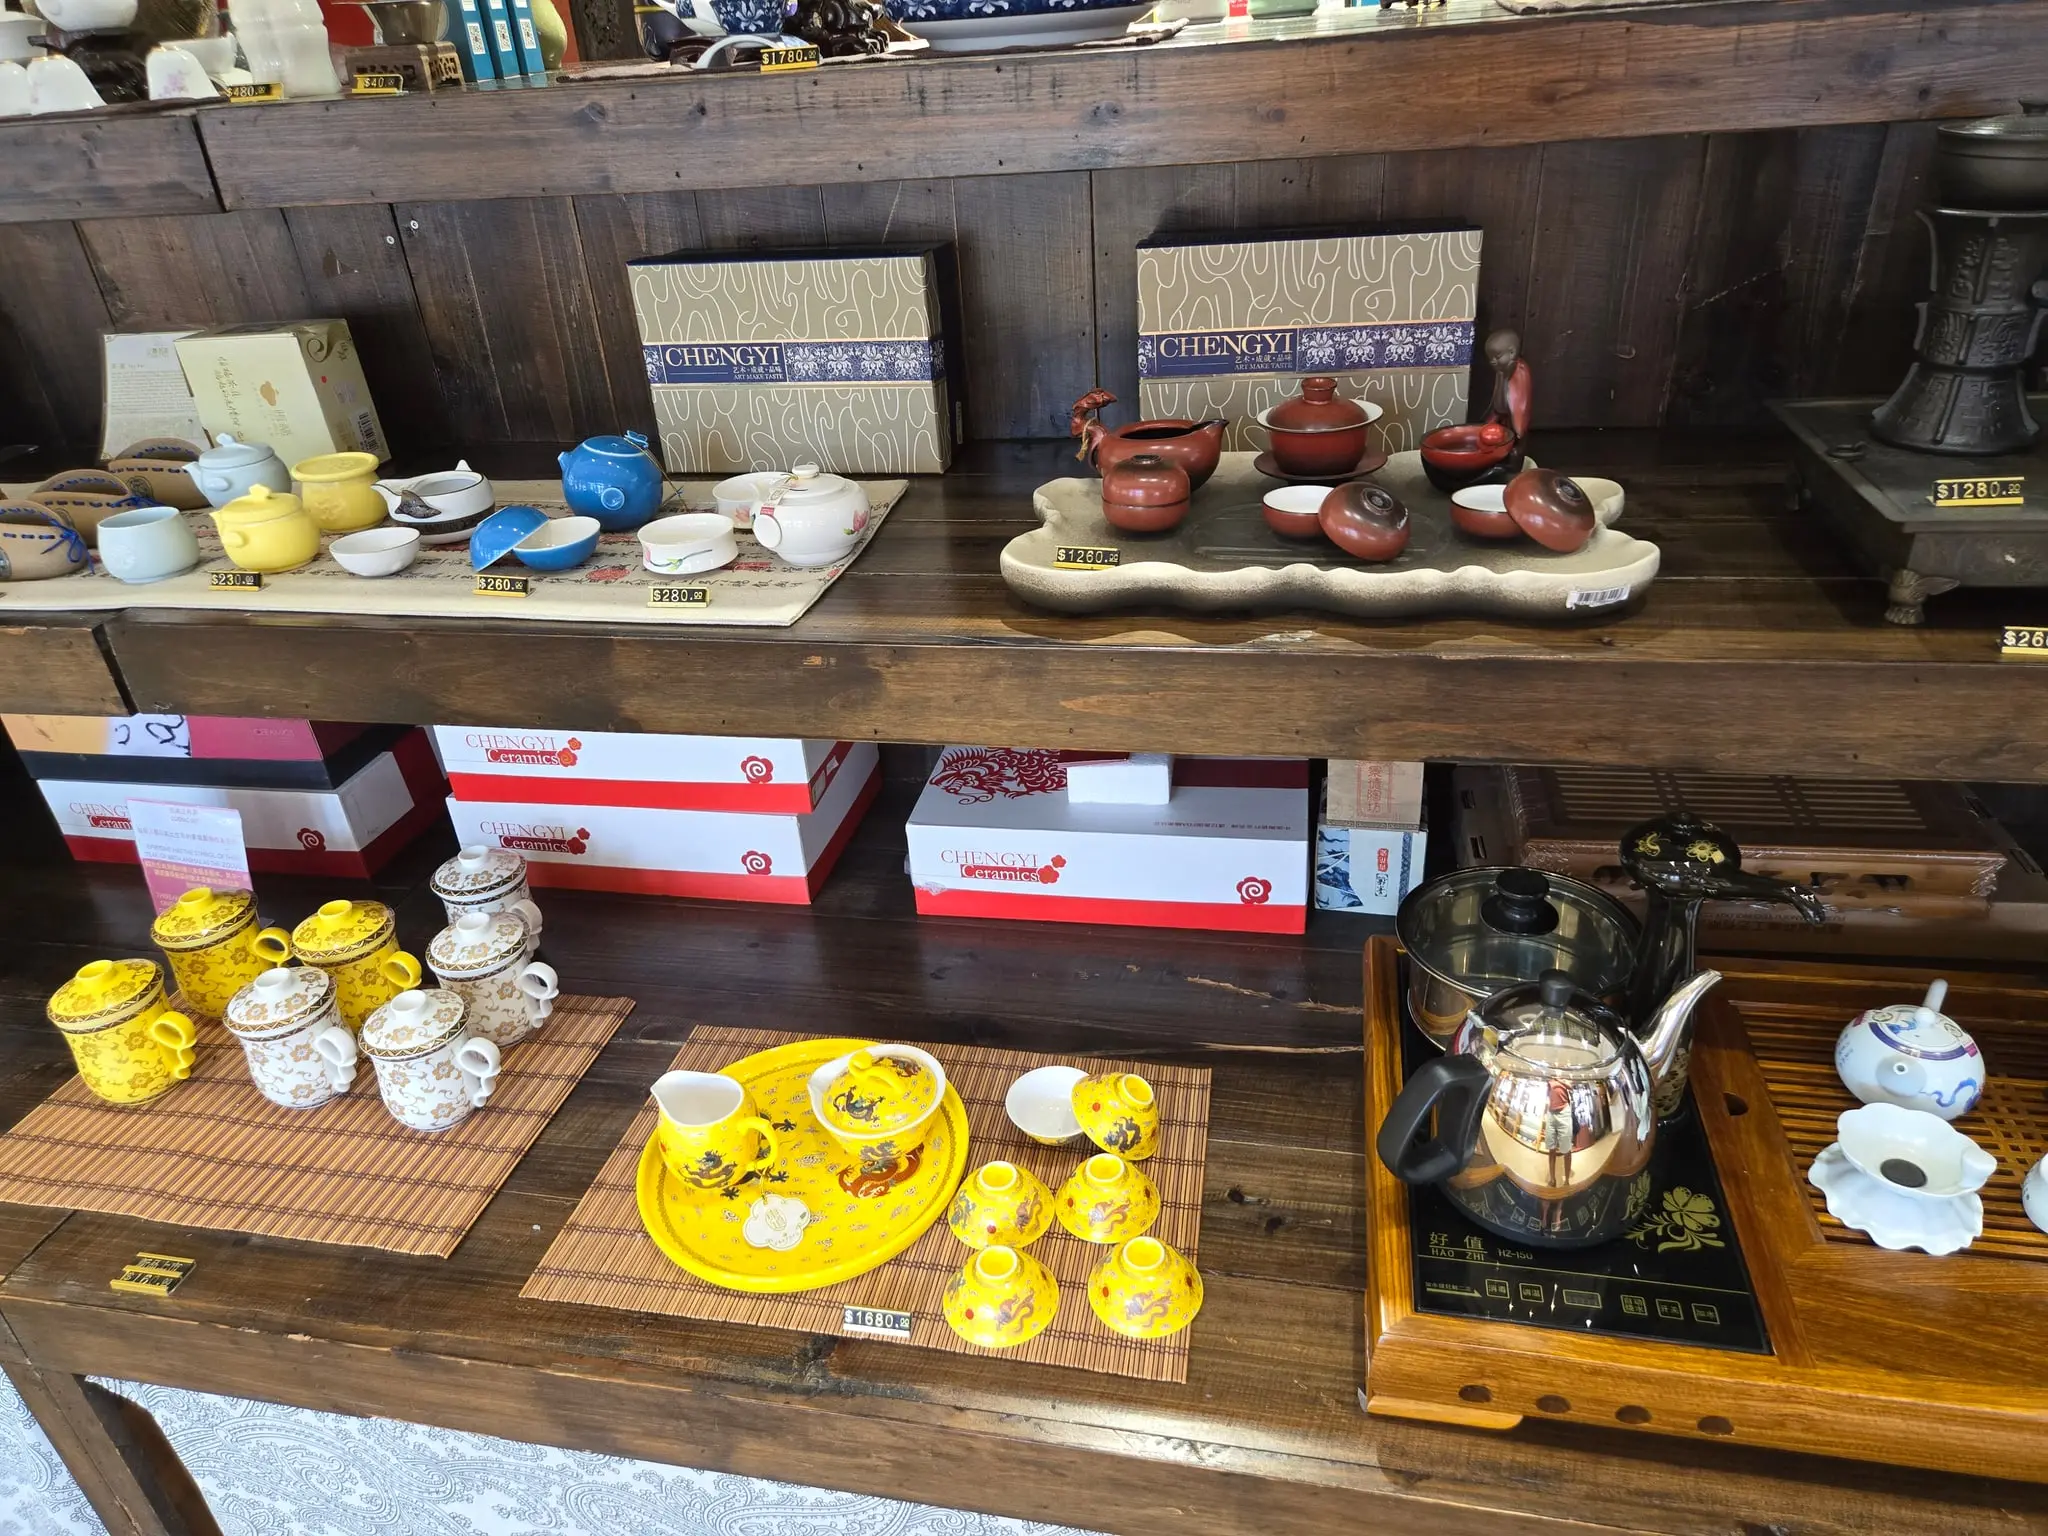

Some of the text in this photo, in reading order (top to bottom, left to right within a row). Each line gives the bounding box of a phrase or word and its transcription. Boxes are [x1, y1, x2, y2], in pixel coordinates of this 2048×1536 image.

[1159, 332, 1294, 358] CHENGYI
[665, 346, 780, 367] CHENGYI
[1234, 363, 1248, 371] ART
[1937, 481, 2021, 500] $1280.00
[1057, 548, 1119, 564] $1260.00
[2003, 630, 2048, 647] $26
[465, 733, 557, 751] CHENGYI
[487, 748, 560, 766] Ceramics
[480, 821, 565, 839] CHENGYI
[500, 835, 570, 853] Ceramics
[940, 849, 1038, 868] CHENGYI
[961, 864, 1039, 882] Ceramics
[1431, 1247, 1485, 1262] HAO ZHI
[844, 1309, 911, 1329] $1680.00
